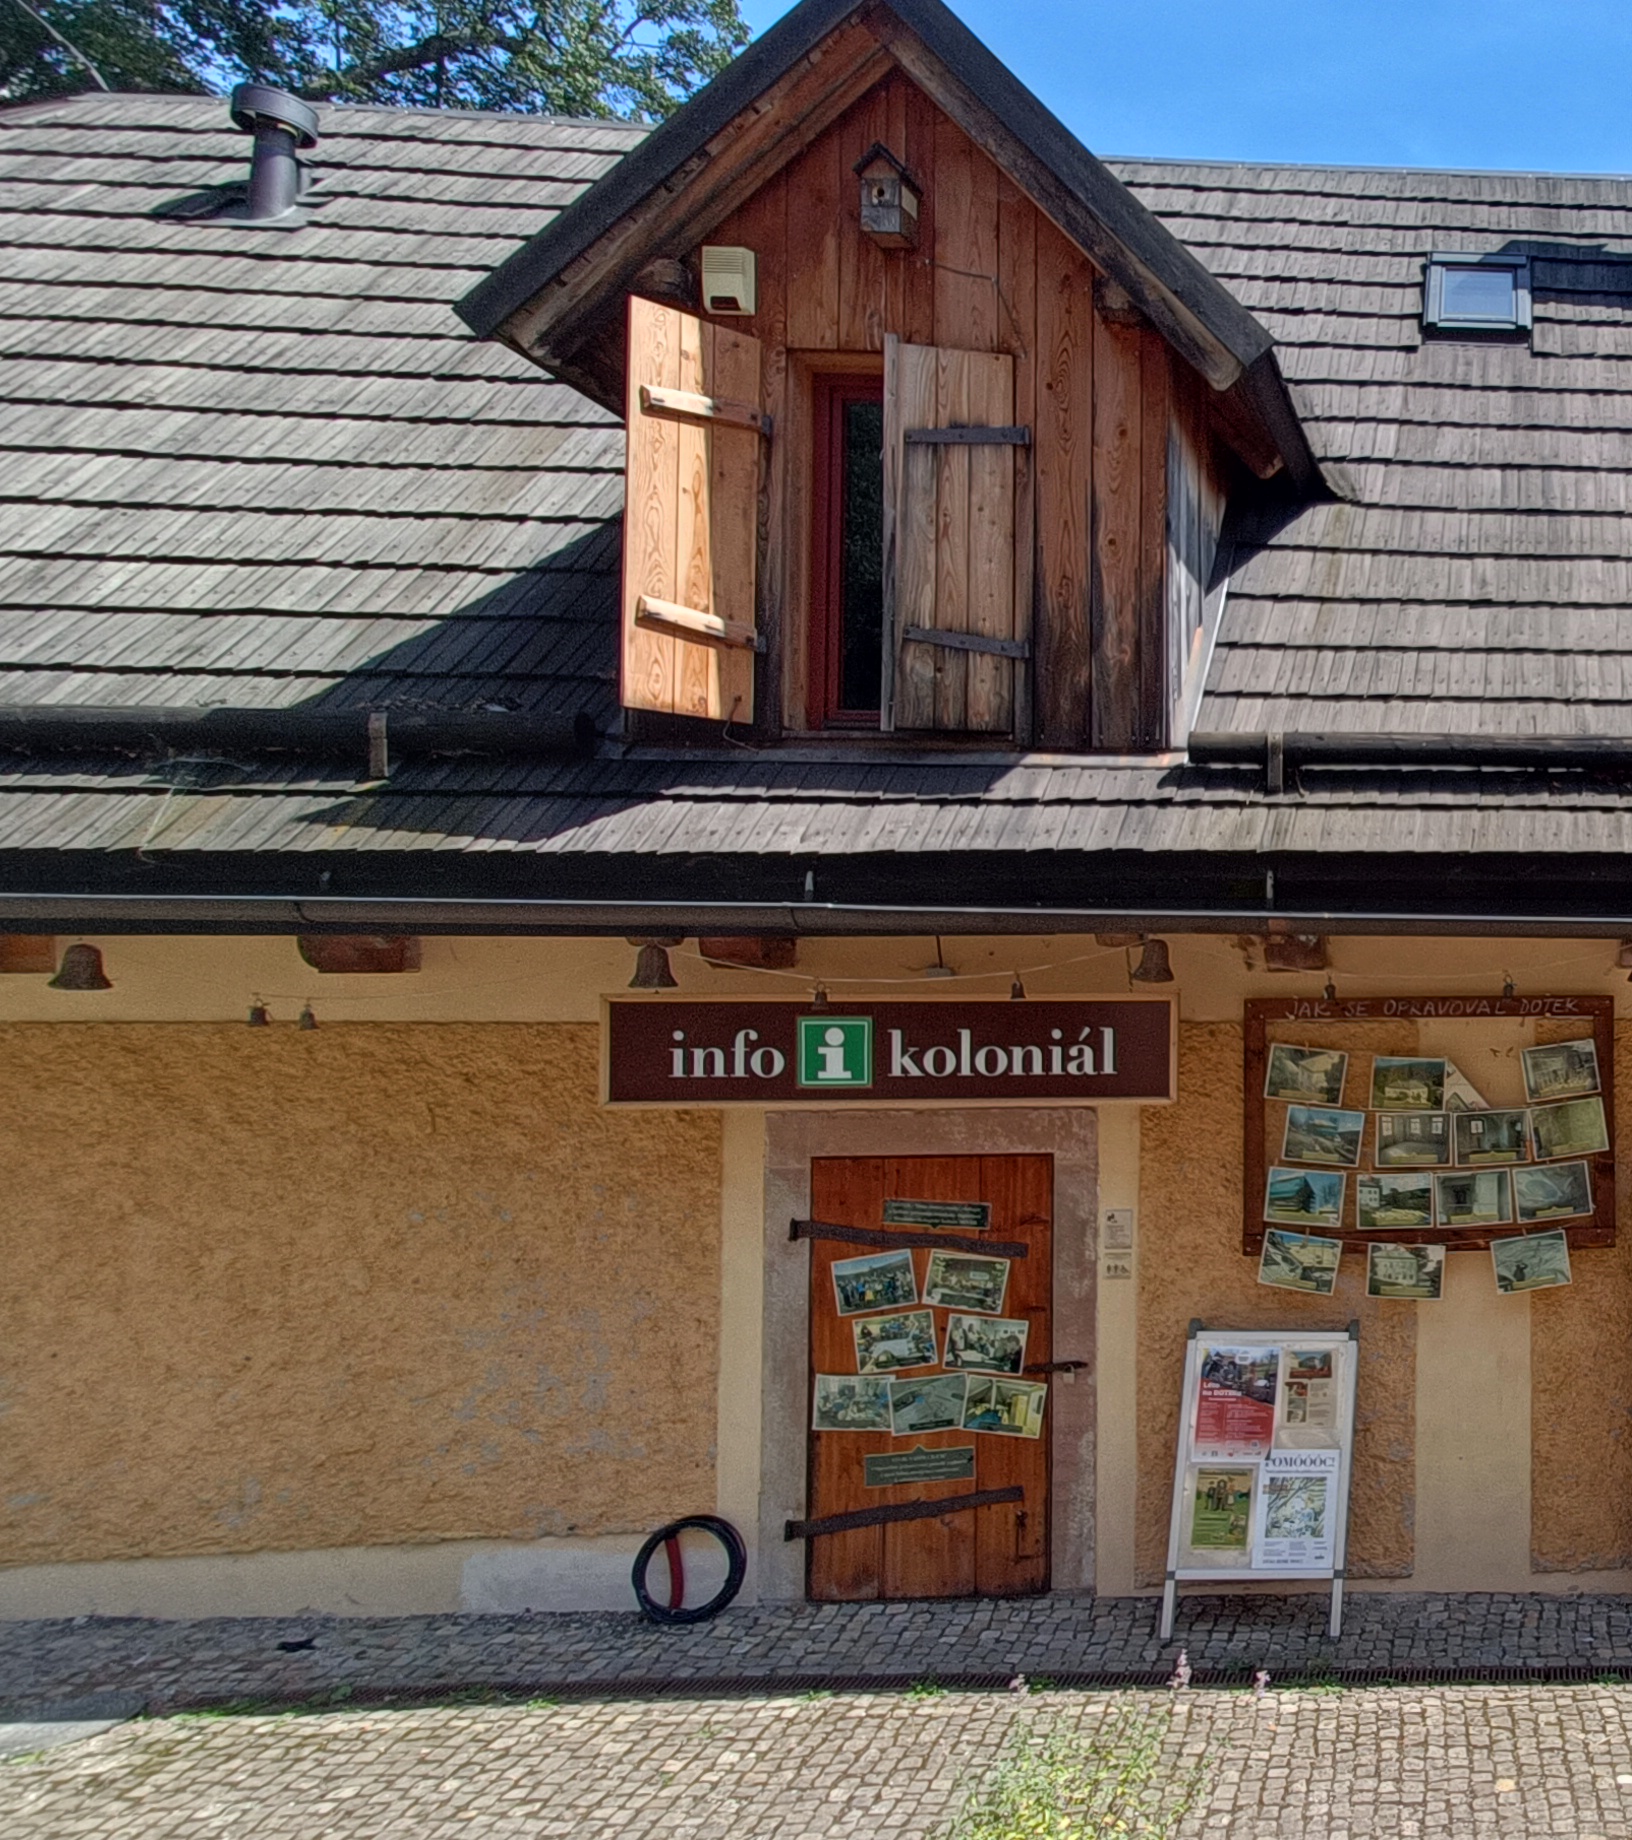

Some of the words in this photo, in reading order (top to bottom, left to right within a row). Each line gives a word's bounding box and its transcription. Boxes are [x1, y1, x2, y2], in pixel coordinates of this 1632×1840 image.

[1293, 999, 1332, 1017] JAK
[1345, 1000, 1371, 1017] SE
[1383, 1000, 1506, 1017] OPRAVOVAL
[1521, 998, 1579, 1014] DOTEK
[668, 1028, 786, 1079] info
[887, 1026, 1118, 1078] koloniál
